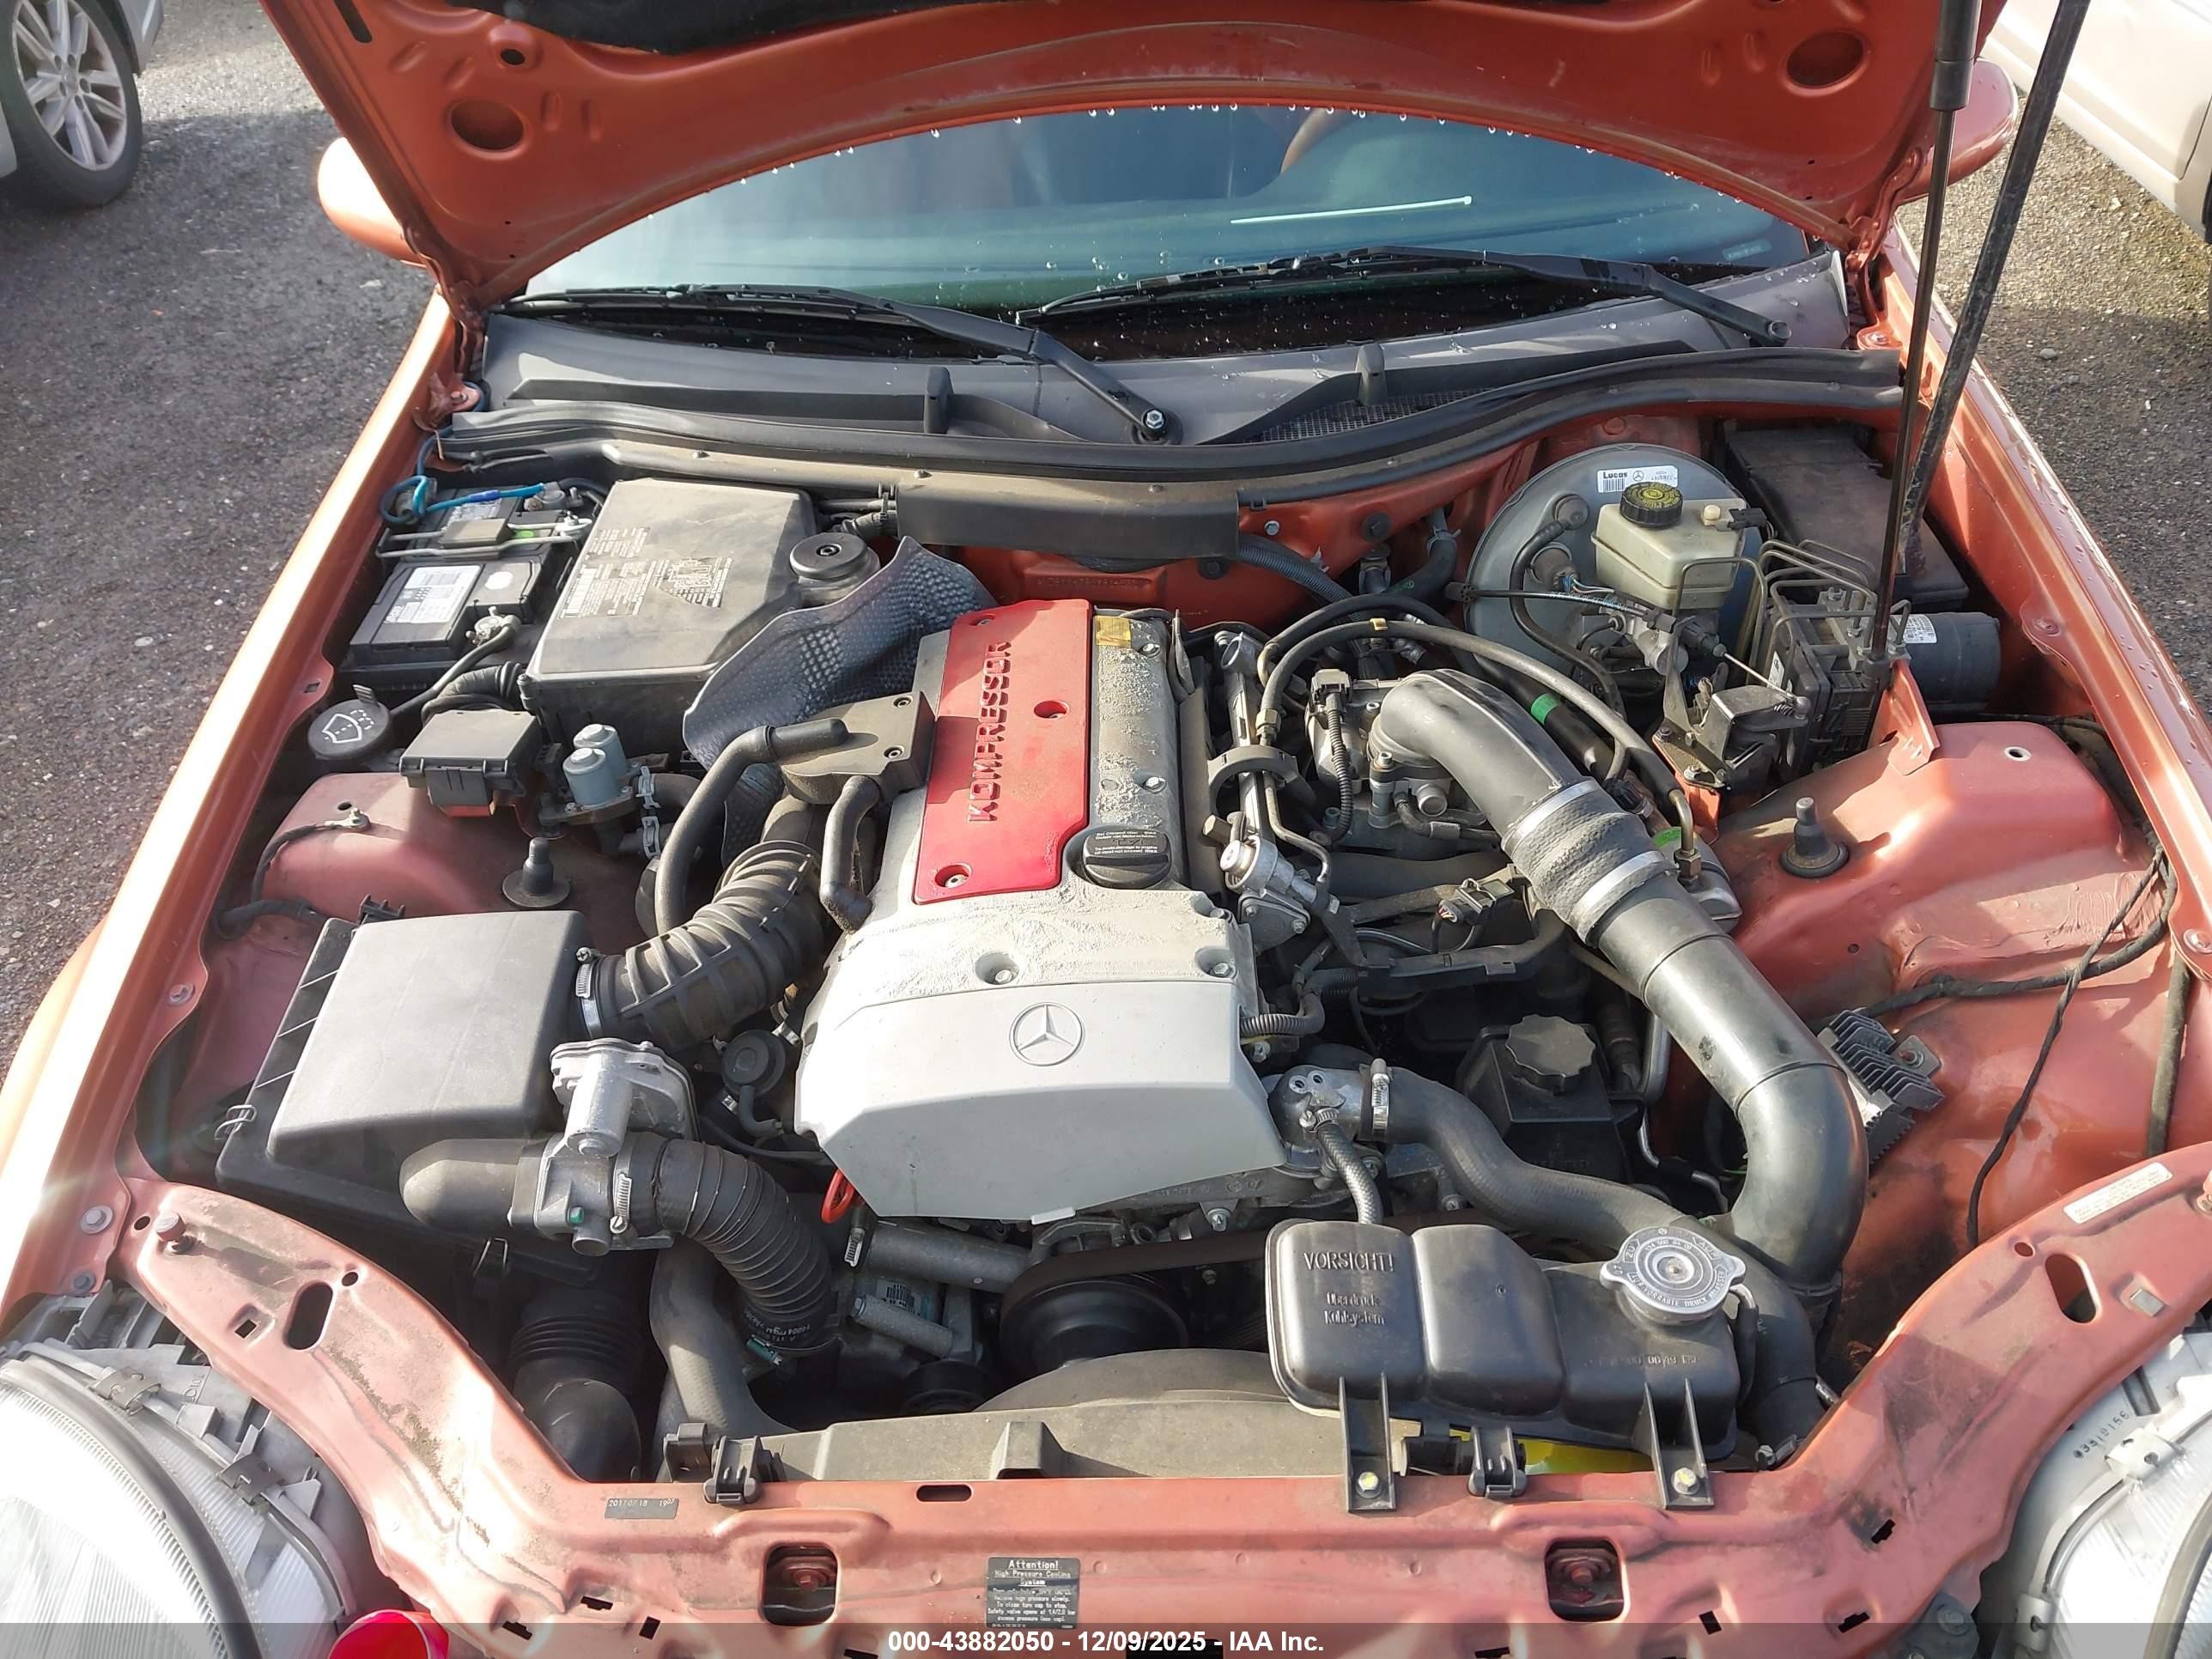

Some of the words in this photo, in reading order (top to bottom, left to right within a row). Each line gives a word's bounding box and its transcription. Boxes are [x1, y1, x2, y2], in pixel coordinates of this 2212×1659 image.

[968, 641, 1012, 822] KOMPRESSOR
[1626, 1246, 1636, 1257] ZU
[1304, 1251, 1395, 1272] VORSICHT!
[1008, 1559, 1059, 1569] Attention!
